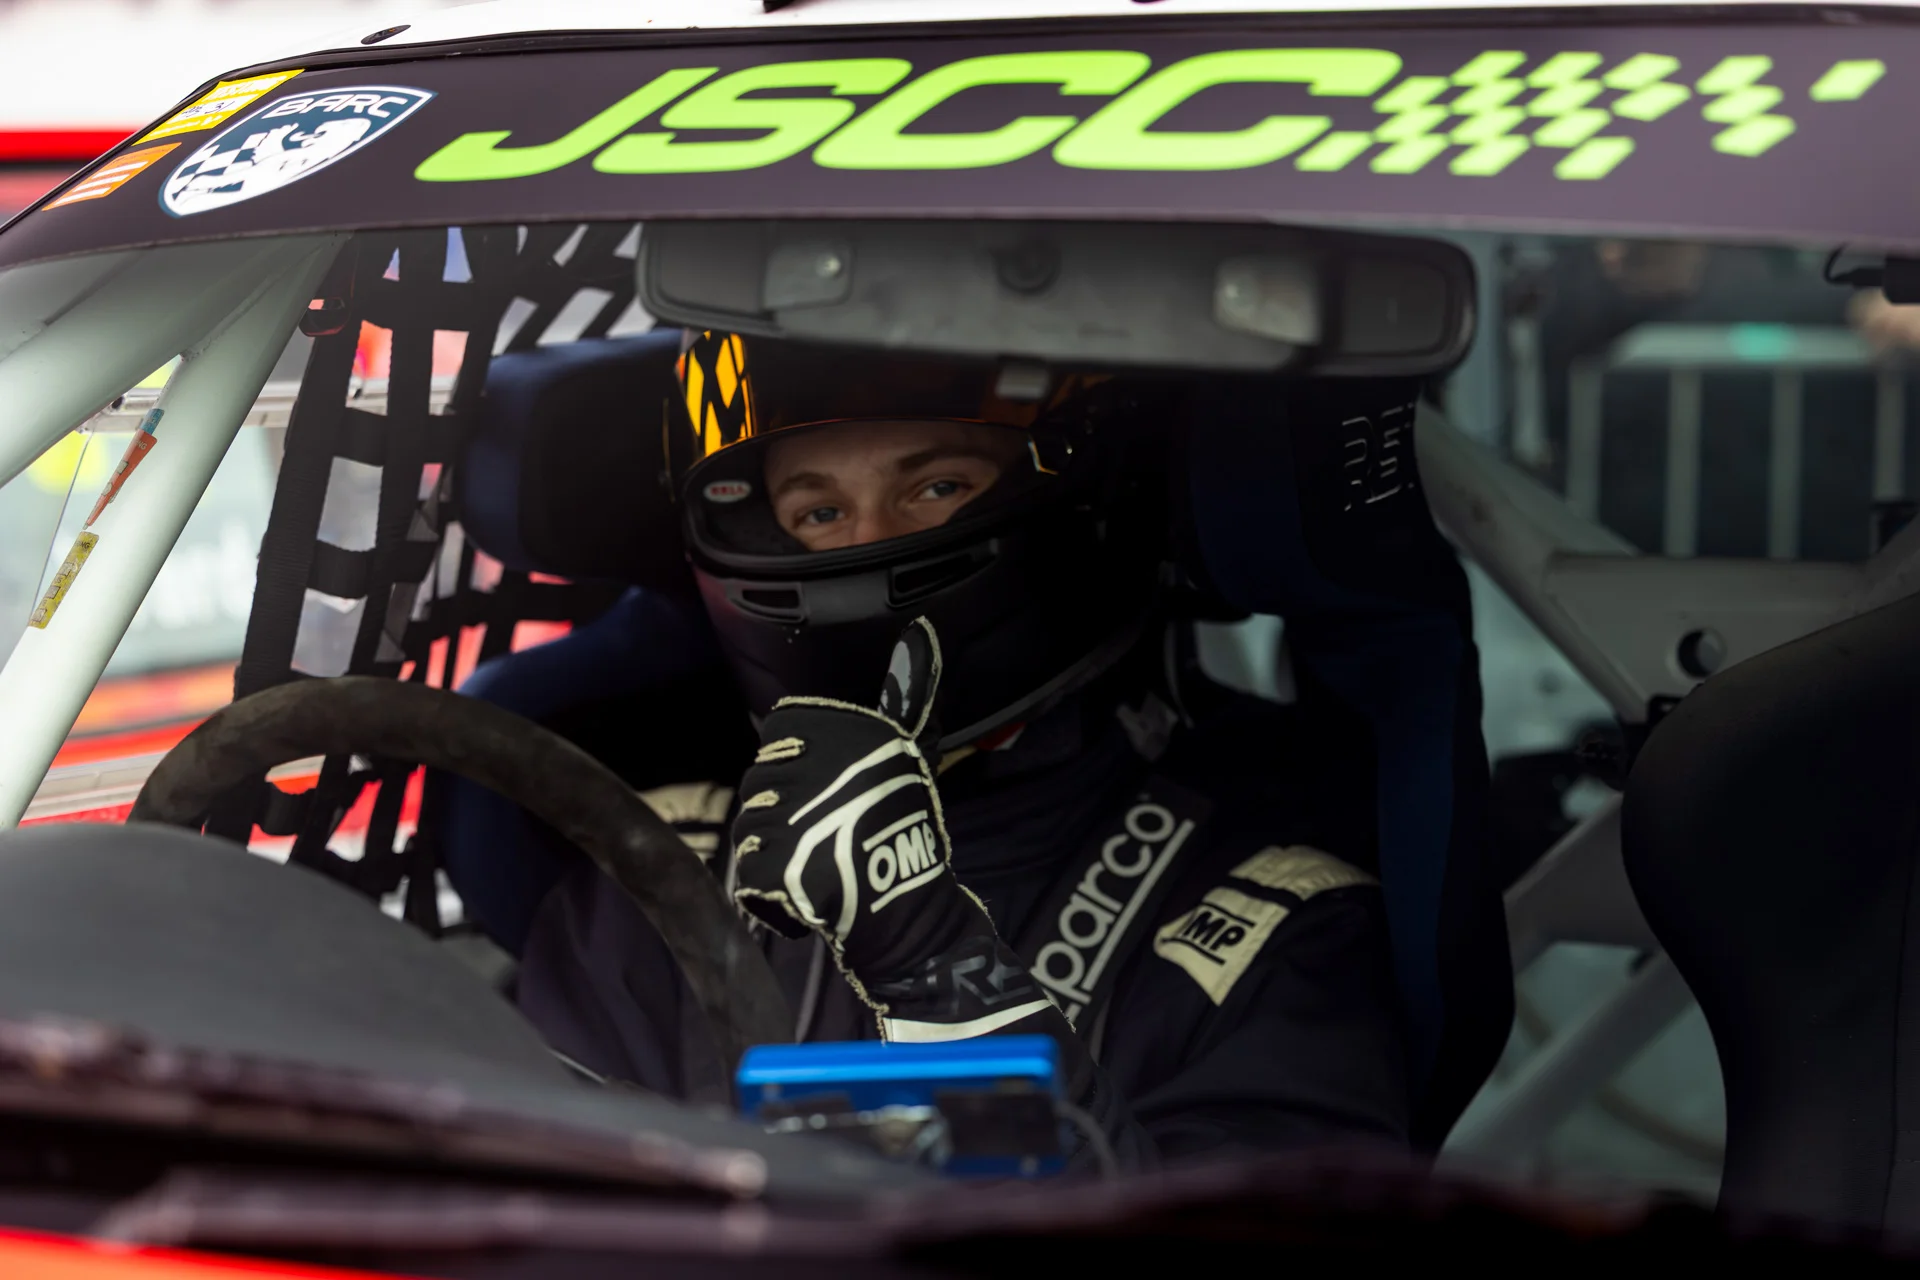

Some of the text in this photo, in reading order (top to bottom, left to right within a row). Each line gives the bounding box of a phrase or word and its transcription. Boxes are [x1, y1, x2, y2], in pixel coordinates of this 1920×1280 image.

[261, 94, 408, 119] BARC
[415, 48, 1402, 182] JSCC
[867, 822, 938, 893] OMP
[1029, 804, 1174, 1005] parco
[1183, 910, 1246, 951] MP
